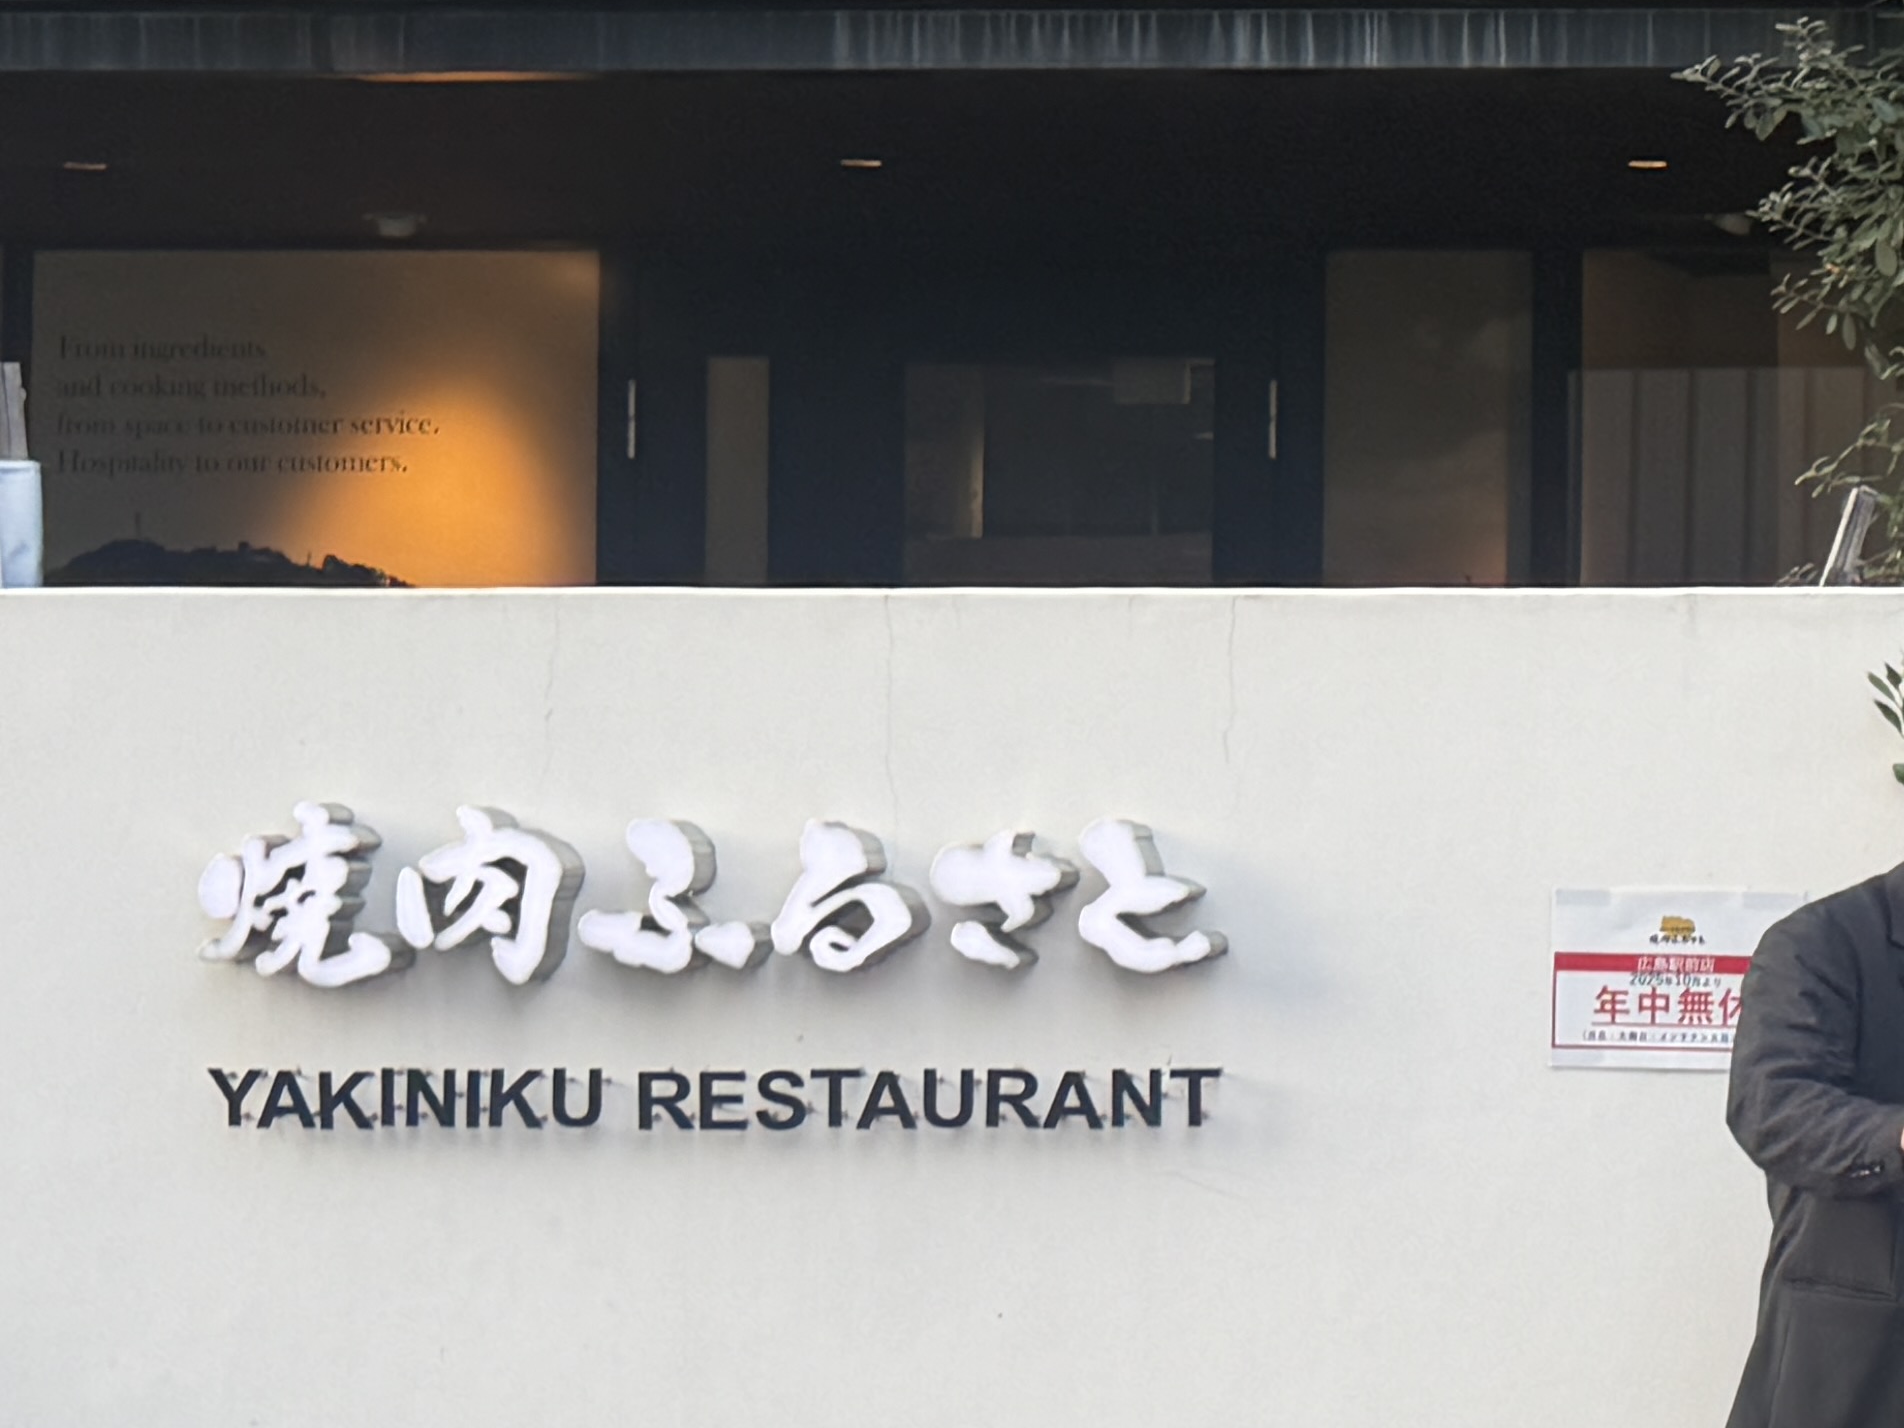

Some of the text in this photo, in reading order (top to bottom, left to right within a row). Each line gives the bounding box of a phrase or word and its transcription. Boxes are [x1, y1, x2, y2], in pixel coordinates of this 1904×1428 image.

[60, 335, 267, 361] From ingredients
[110, 374, 205, 401] cooking
[200, 415, 221, 435] to
[229, 414, 342, 436] customer
[58, 451, 187, 476] Hospitality
[197, 453, 219, 473] to
[227, 456, 270, 473] our
[198, 800, 1229, 987] 焼肉ふるさと
[208, 1065, 1224, 1131] YAKINIKU RESTAURANT
